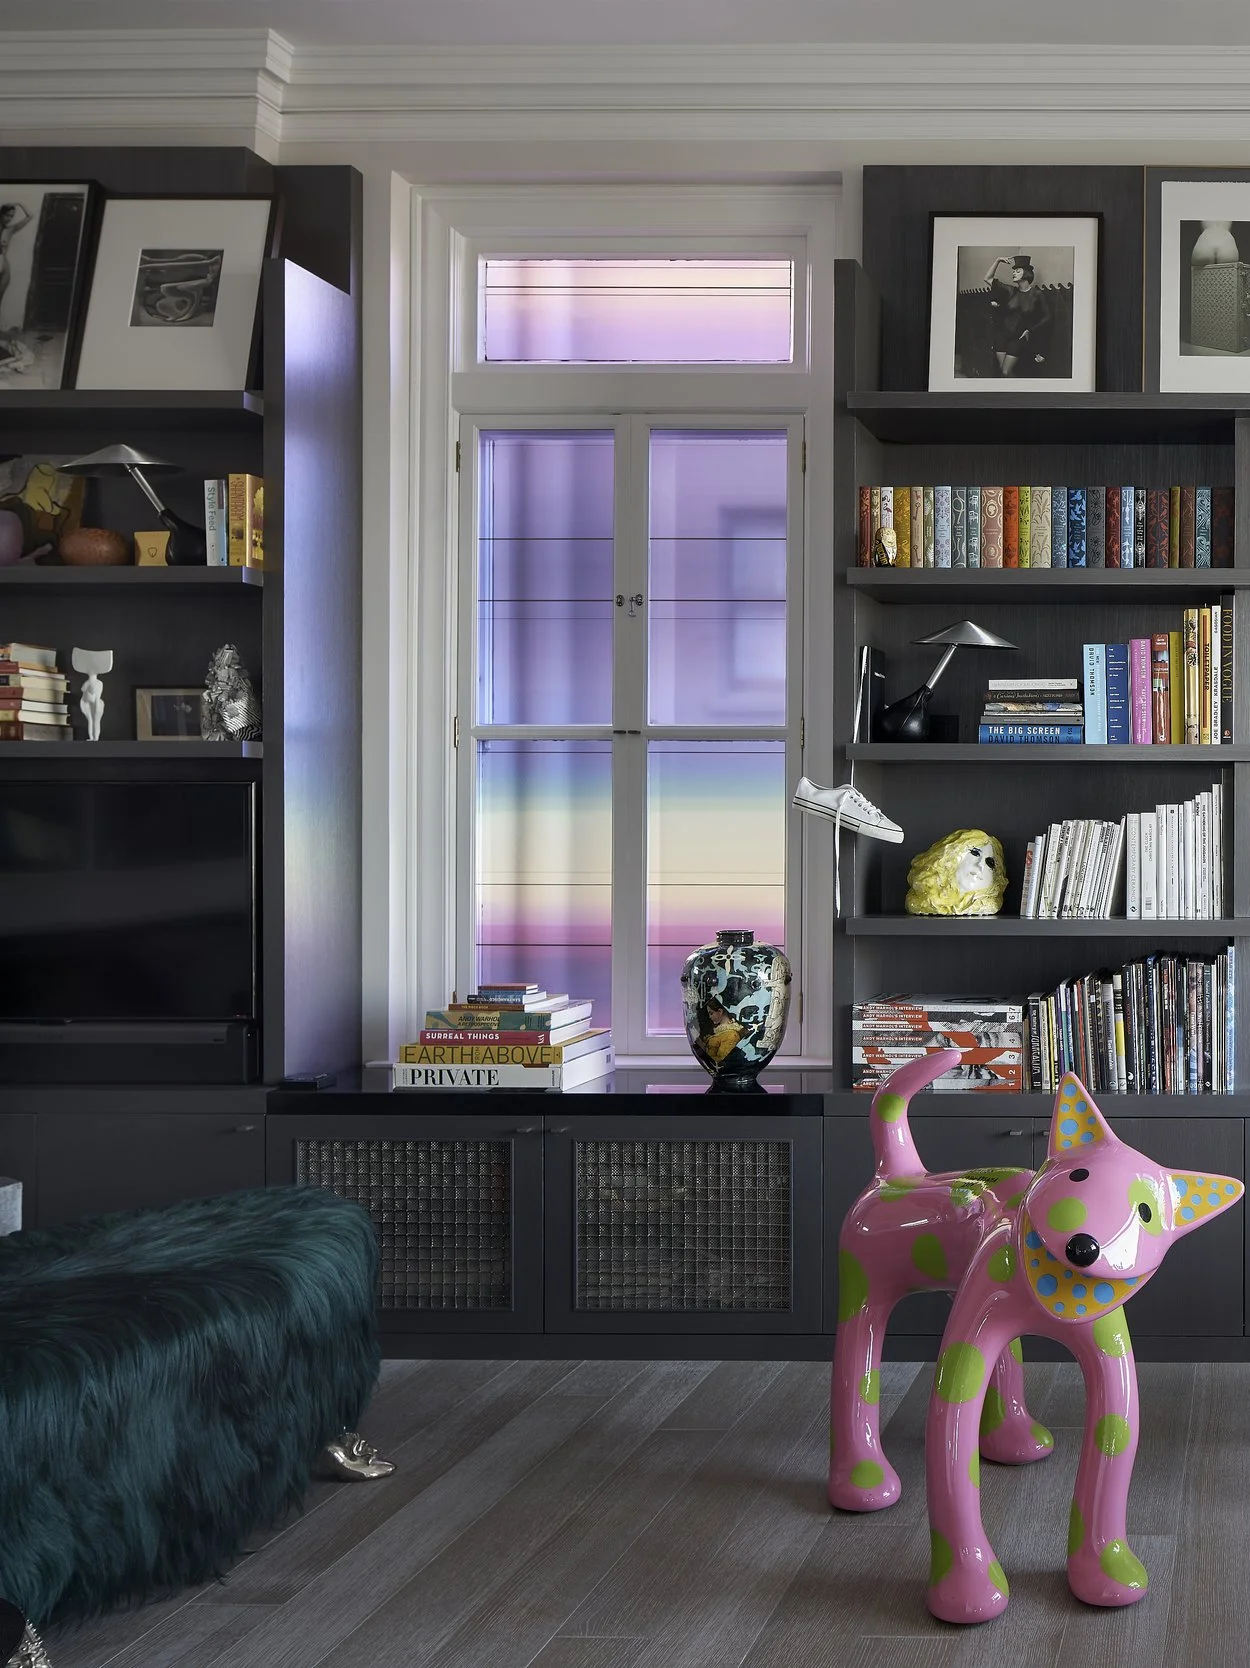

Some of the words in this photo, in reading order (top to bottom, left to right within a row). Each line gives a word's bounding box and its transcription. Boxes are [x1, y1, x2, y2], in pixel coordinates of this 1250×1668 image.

[206, 487, 216, 509] Style
[208, 511, 216, 531] Feed
[1222, 609, 1232, 642] FOOD
[1222, 645, 1232, 658] IN
[1222, 661, 1232, 703] VOGUE
[988, 726, 1004, 734] THE
[1008, 726, 1023, 734] BIG
[1027, 726, 1060, 734] SCREEN
[988, 736, 1015, 744] DAVID
[1018, 735, 1060, 743] THOMSON
[1130, 875, 1138, 903] CERAMICS
[426, 1032, 464, 1040] SURREAL
[405, 1046, 473, 1064] EARTH
[481, 1046, 552, 1064] ABOVE
[411, 1069, 499, 1085] PRIVATE
